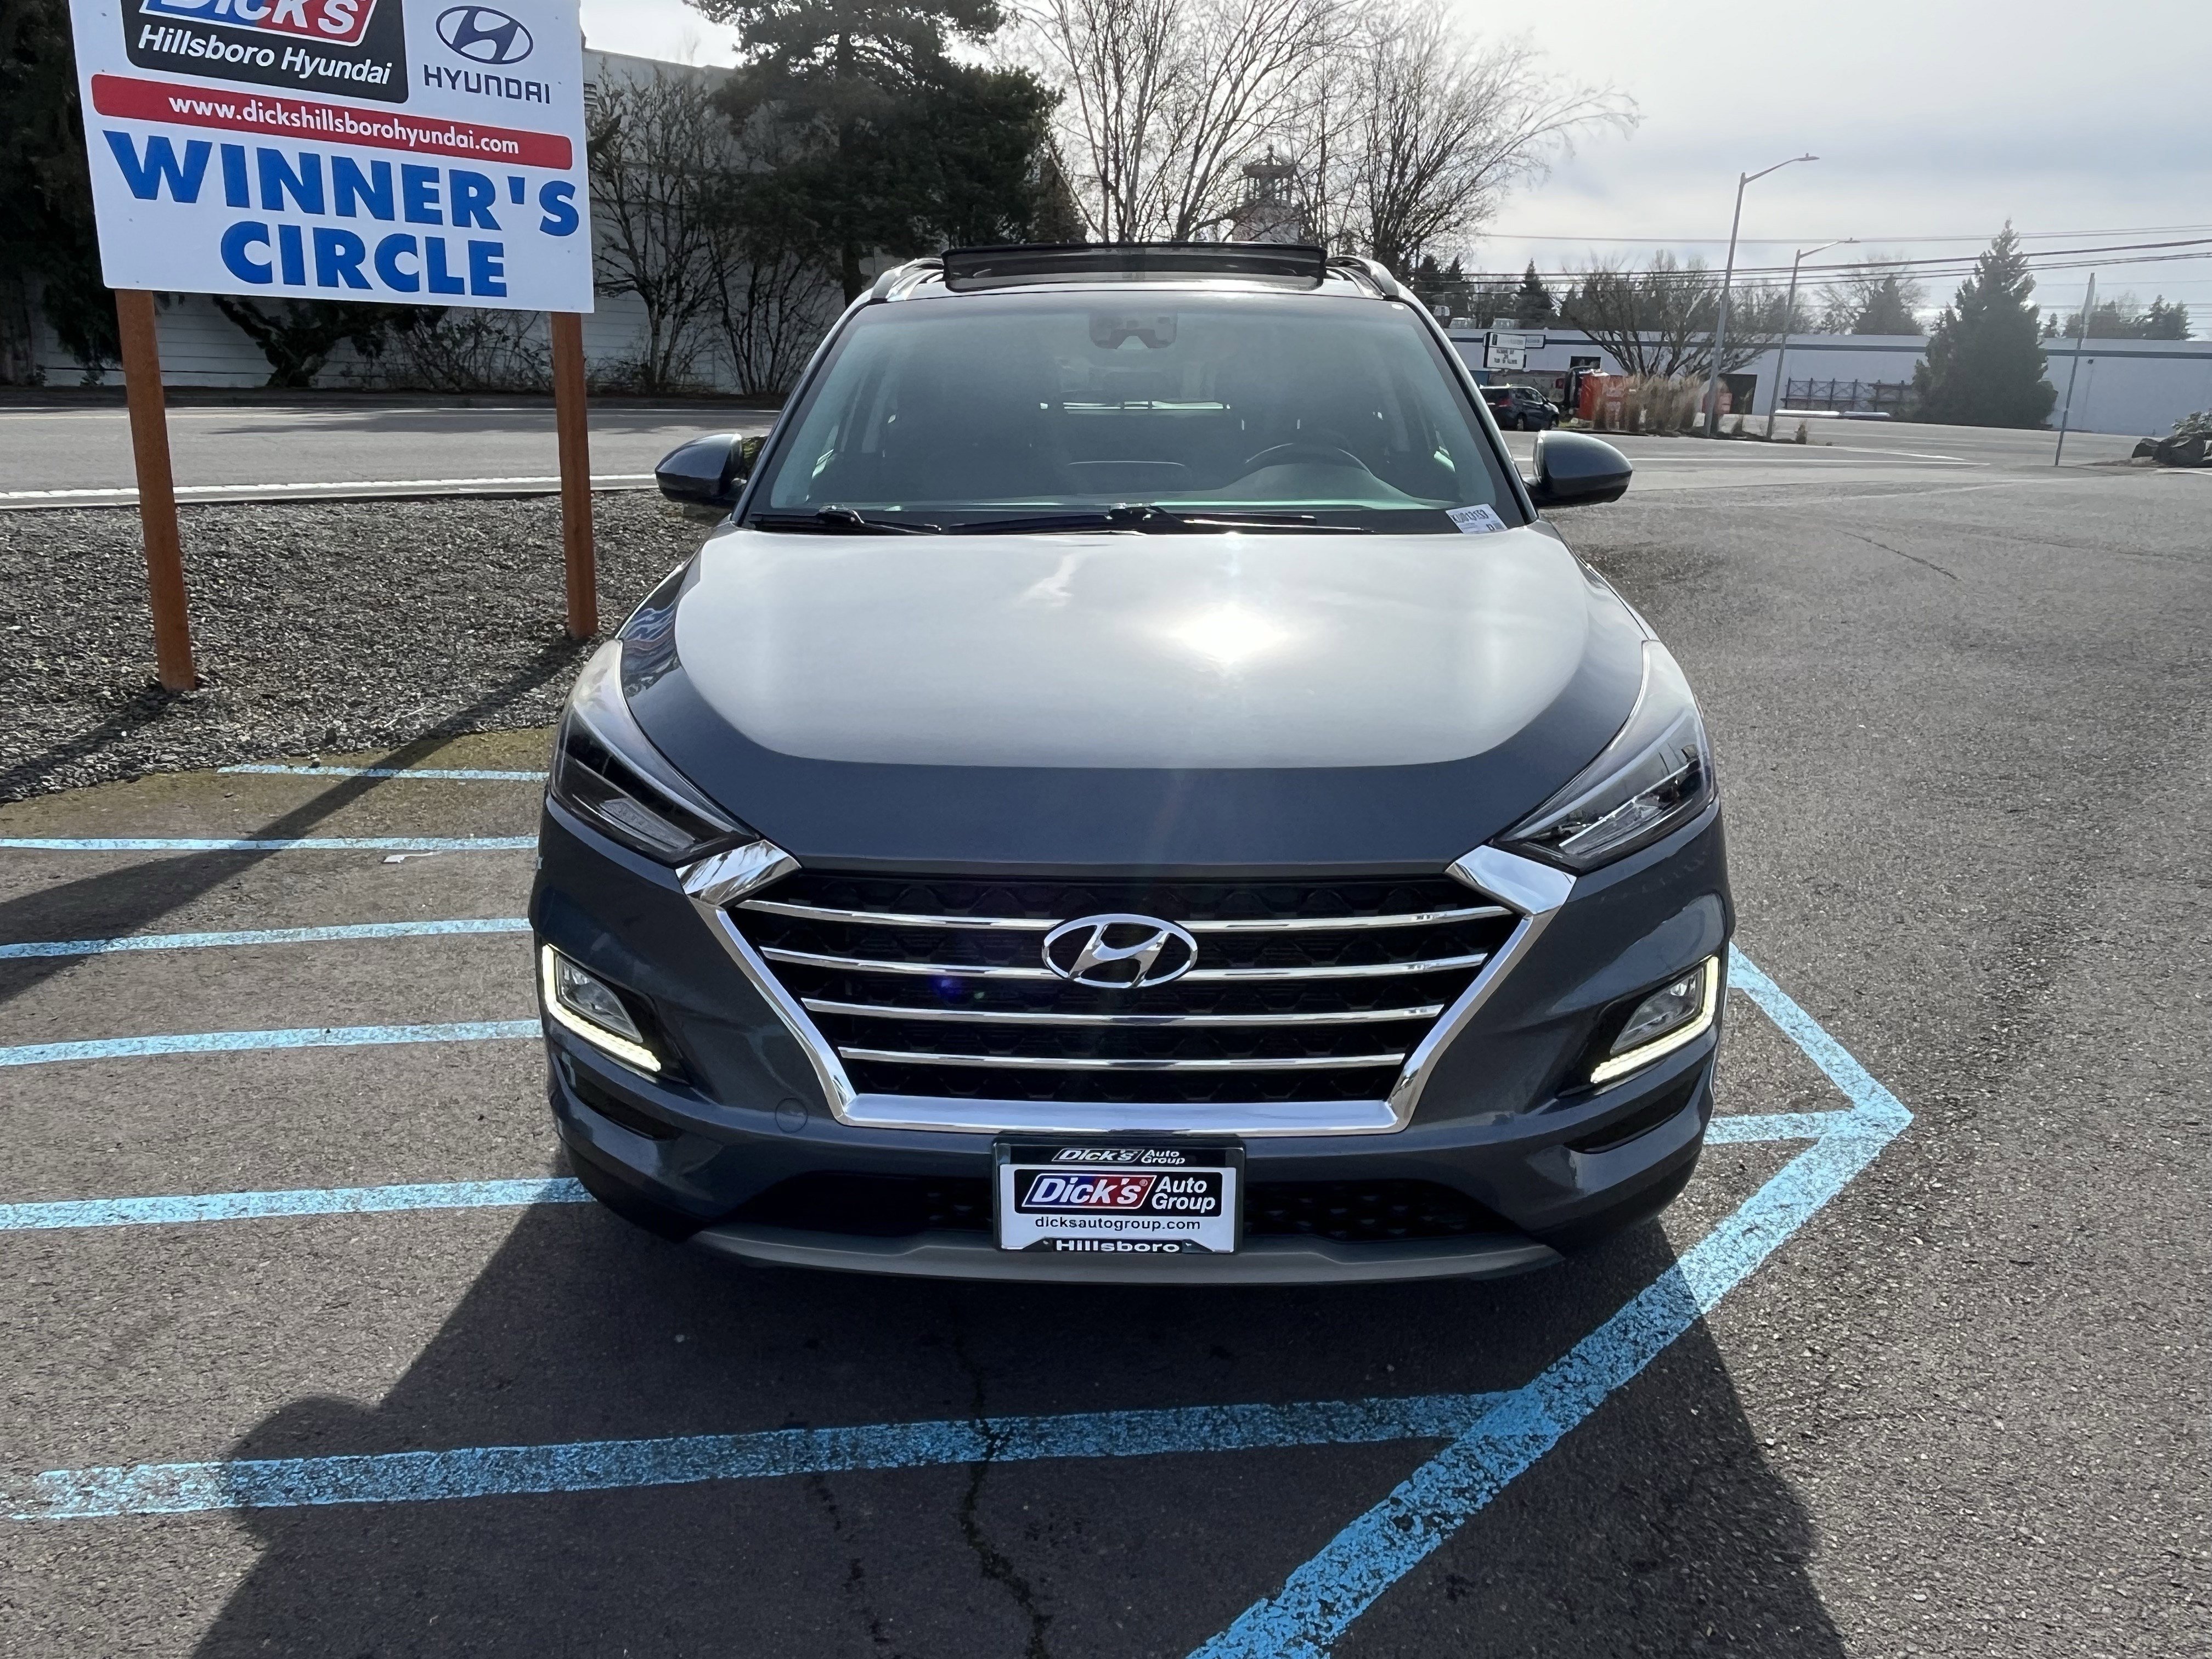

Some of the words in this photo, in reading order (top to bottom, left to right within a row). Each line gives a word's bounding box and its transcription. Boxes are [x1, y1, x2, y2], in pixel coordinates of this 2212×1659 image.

[138, 25, 275, 67] Hillsboro
[281, 47, 392, 84] Hyundai
[424, 64, 550, 104] HYUNDAI
[168, 95, 520, 155] www.dickshillsborohyundai.com
[103, 130, 579, 236] WINNER'S
[220, 221, 508, 298] CIRCLE
[1141, 1156, 1186, 1165] Group
[1146, 1149, 1180, 1158] Auto
[1031, 1177, 1142, 1205] Dick's
[1155, 1176, 1207, 1194] Auto
[1152, 1193, 1216, 1214] Group
[1035, 1216, 1201, 1232] dicksautogroup.com
[1056, 1239, 1180, 1253] Hillsboro
